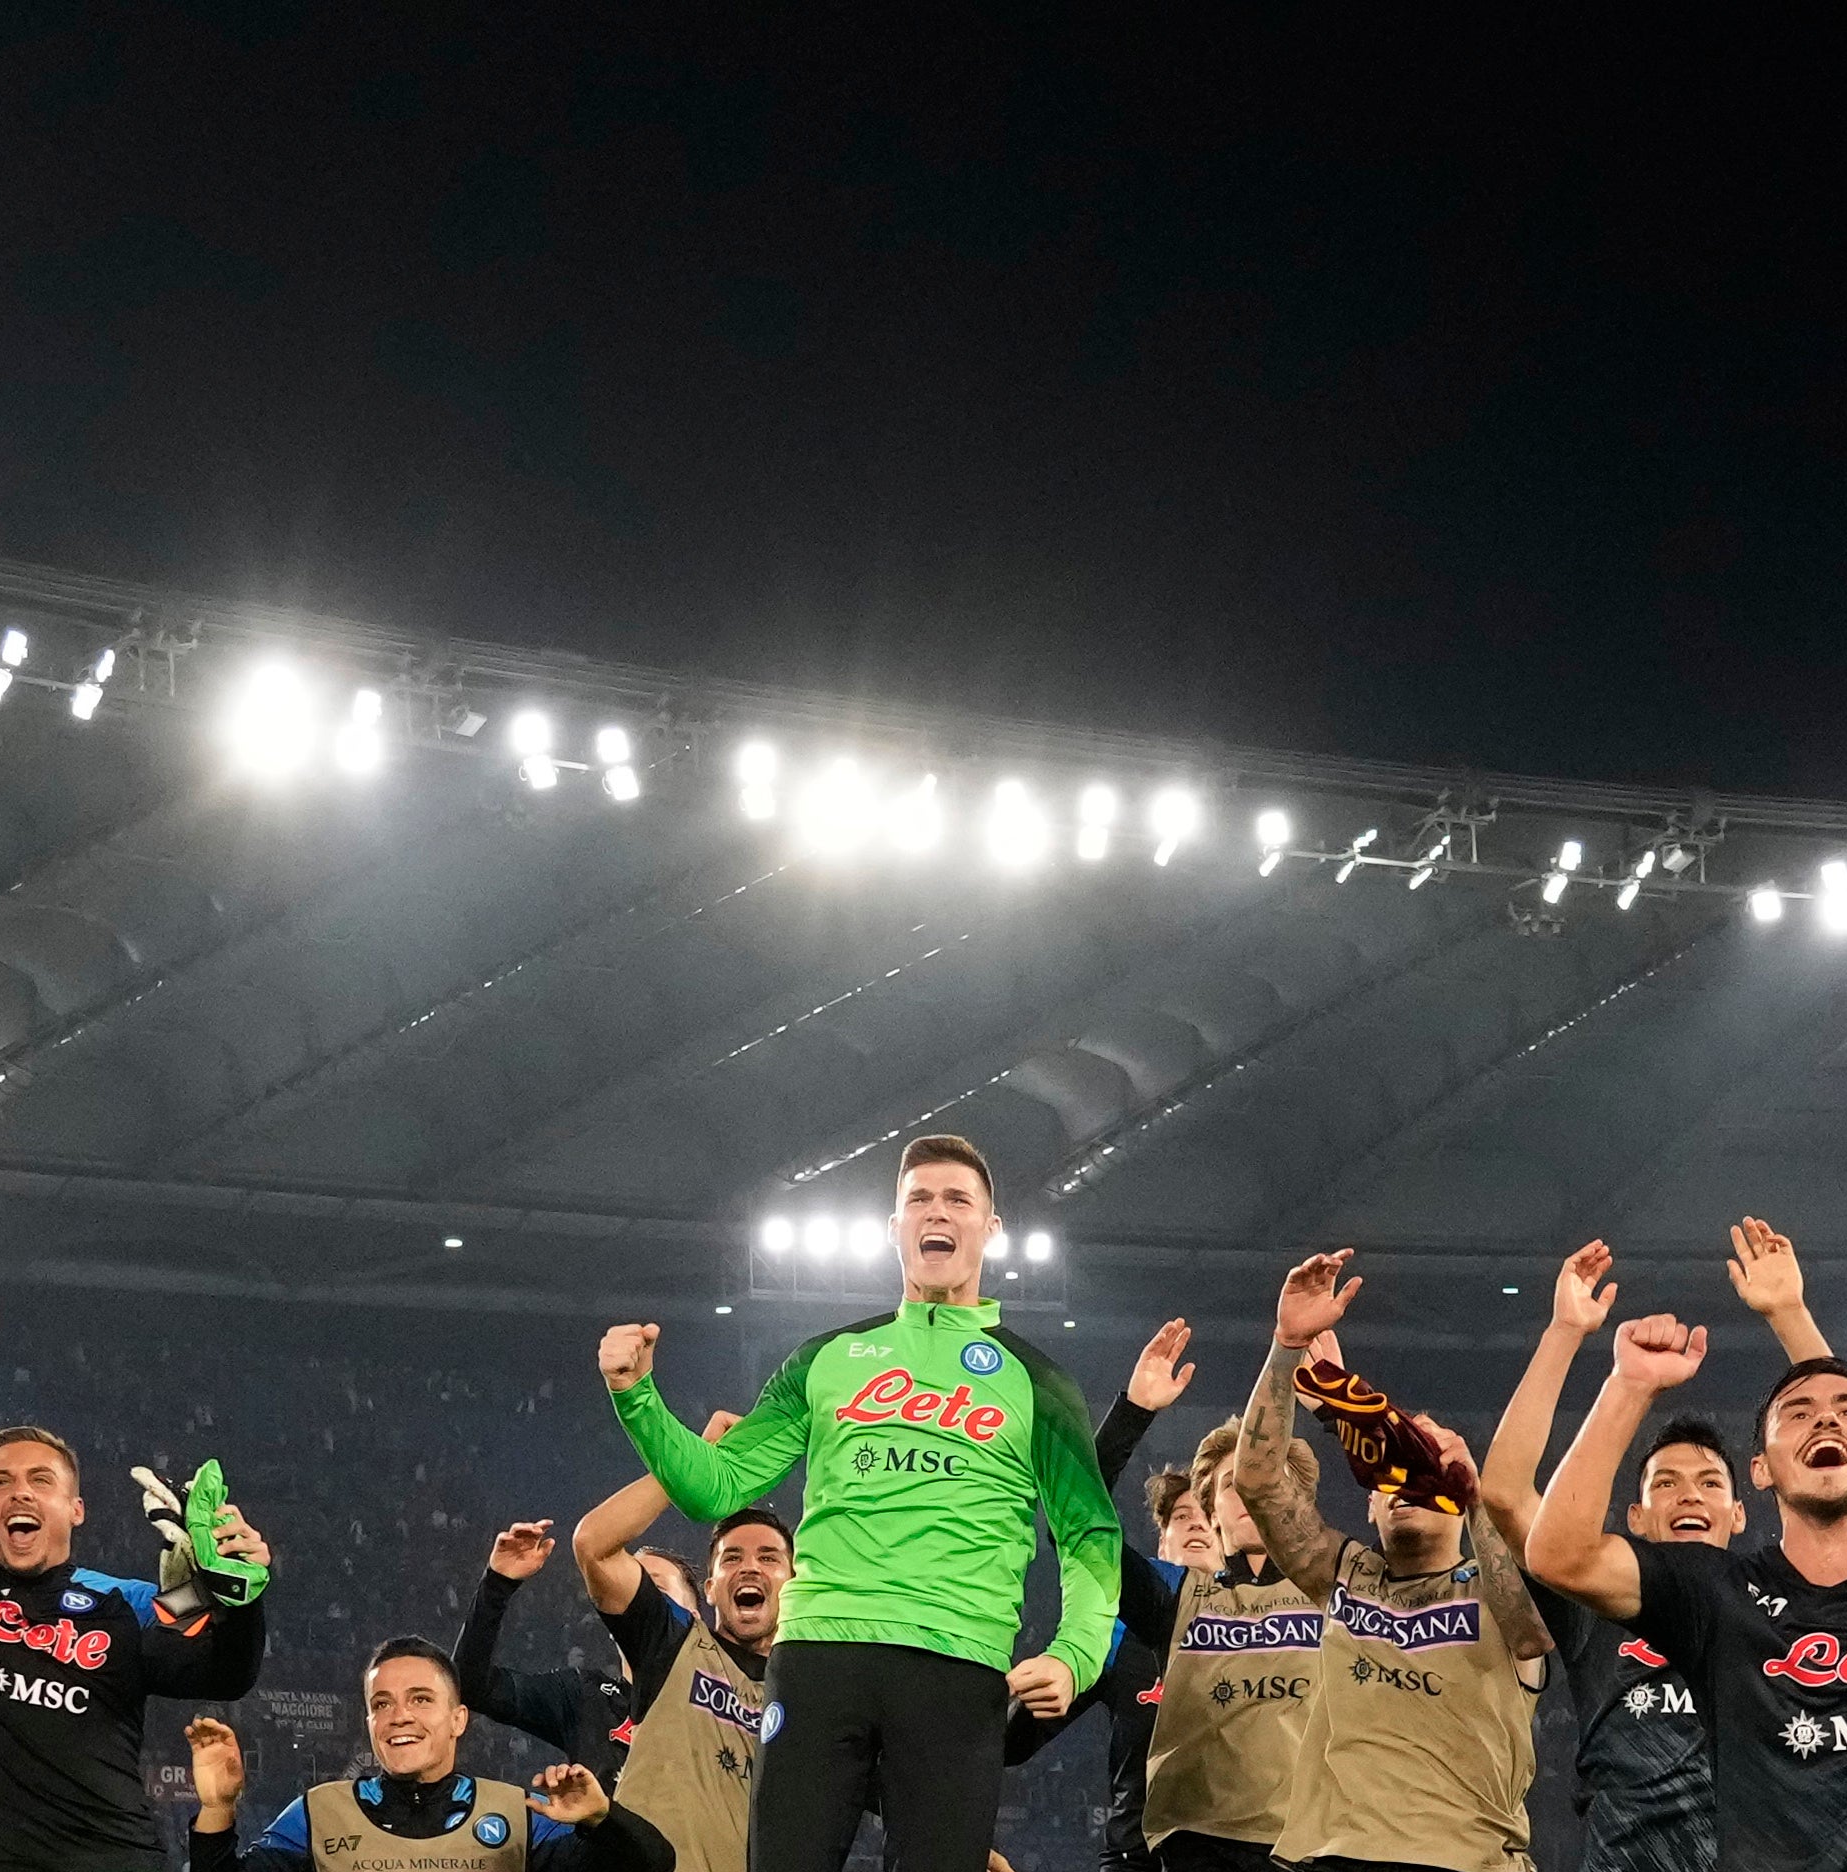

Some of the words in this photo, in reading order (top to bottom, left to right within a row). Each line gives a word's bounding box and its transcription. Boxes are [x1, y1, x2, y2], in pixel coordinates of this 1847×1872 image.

[848, 1342, 893, 1359] EA7
[836, 1367, 1006, 1442] Lete
[883, 1447, 970, 1478] MSC
[1180, 1617, 1322, 1649] SORGESAN
[10, 1672, 90, 1715] MSC
[1242, 1676, 1311, 1699] MSC
[1377, 1665, 1443, 1696] MSC
[324, 1834, 362, 1855] EA7
[352, 1858, 405, 1871] ACQUA
[409, 1857, 487, 1871] MINERALE
